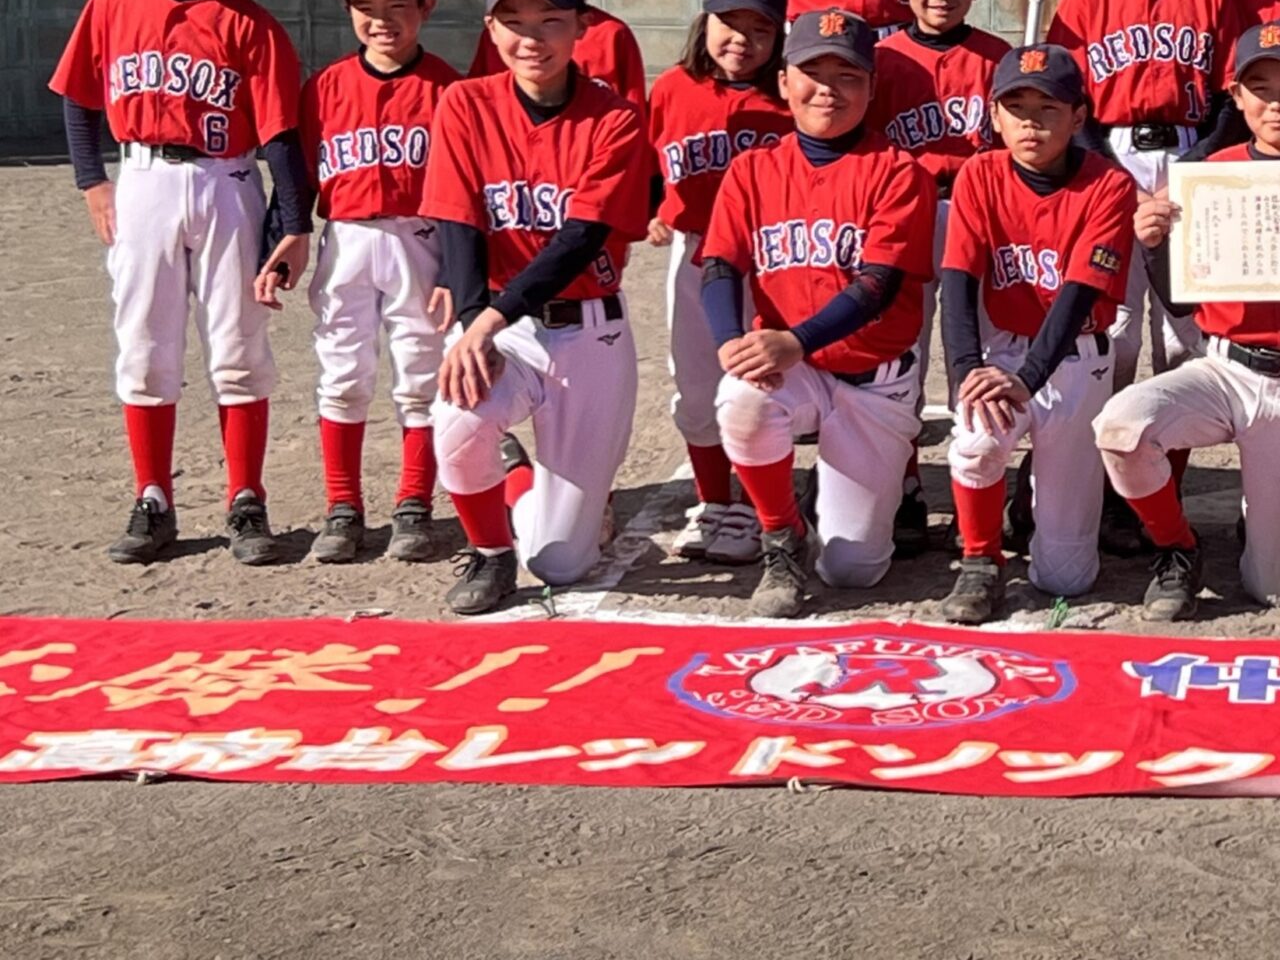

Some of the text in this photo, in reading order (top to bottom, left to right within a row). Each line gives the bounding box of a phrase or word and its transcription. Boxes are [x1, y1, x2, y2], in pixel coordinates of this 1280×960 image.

[110, 51, 242, 111] EDSOX
[1088, 23, 1214, 83] REDSOX
[203, 111, 230, 155] 6
[318, 125, 430, 183] REDSO
[664, 129, 781, 184] REDS
[752, 218, 866, 278] EDSO
